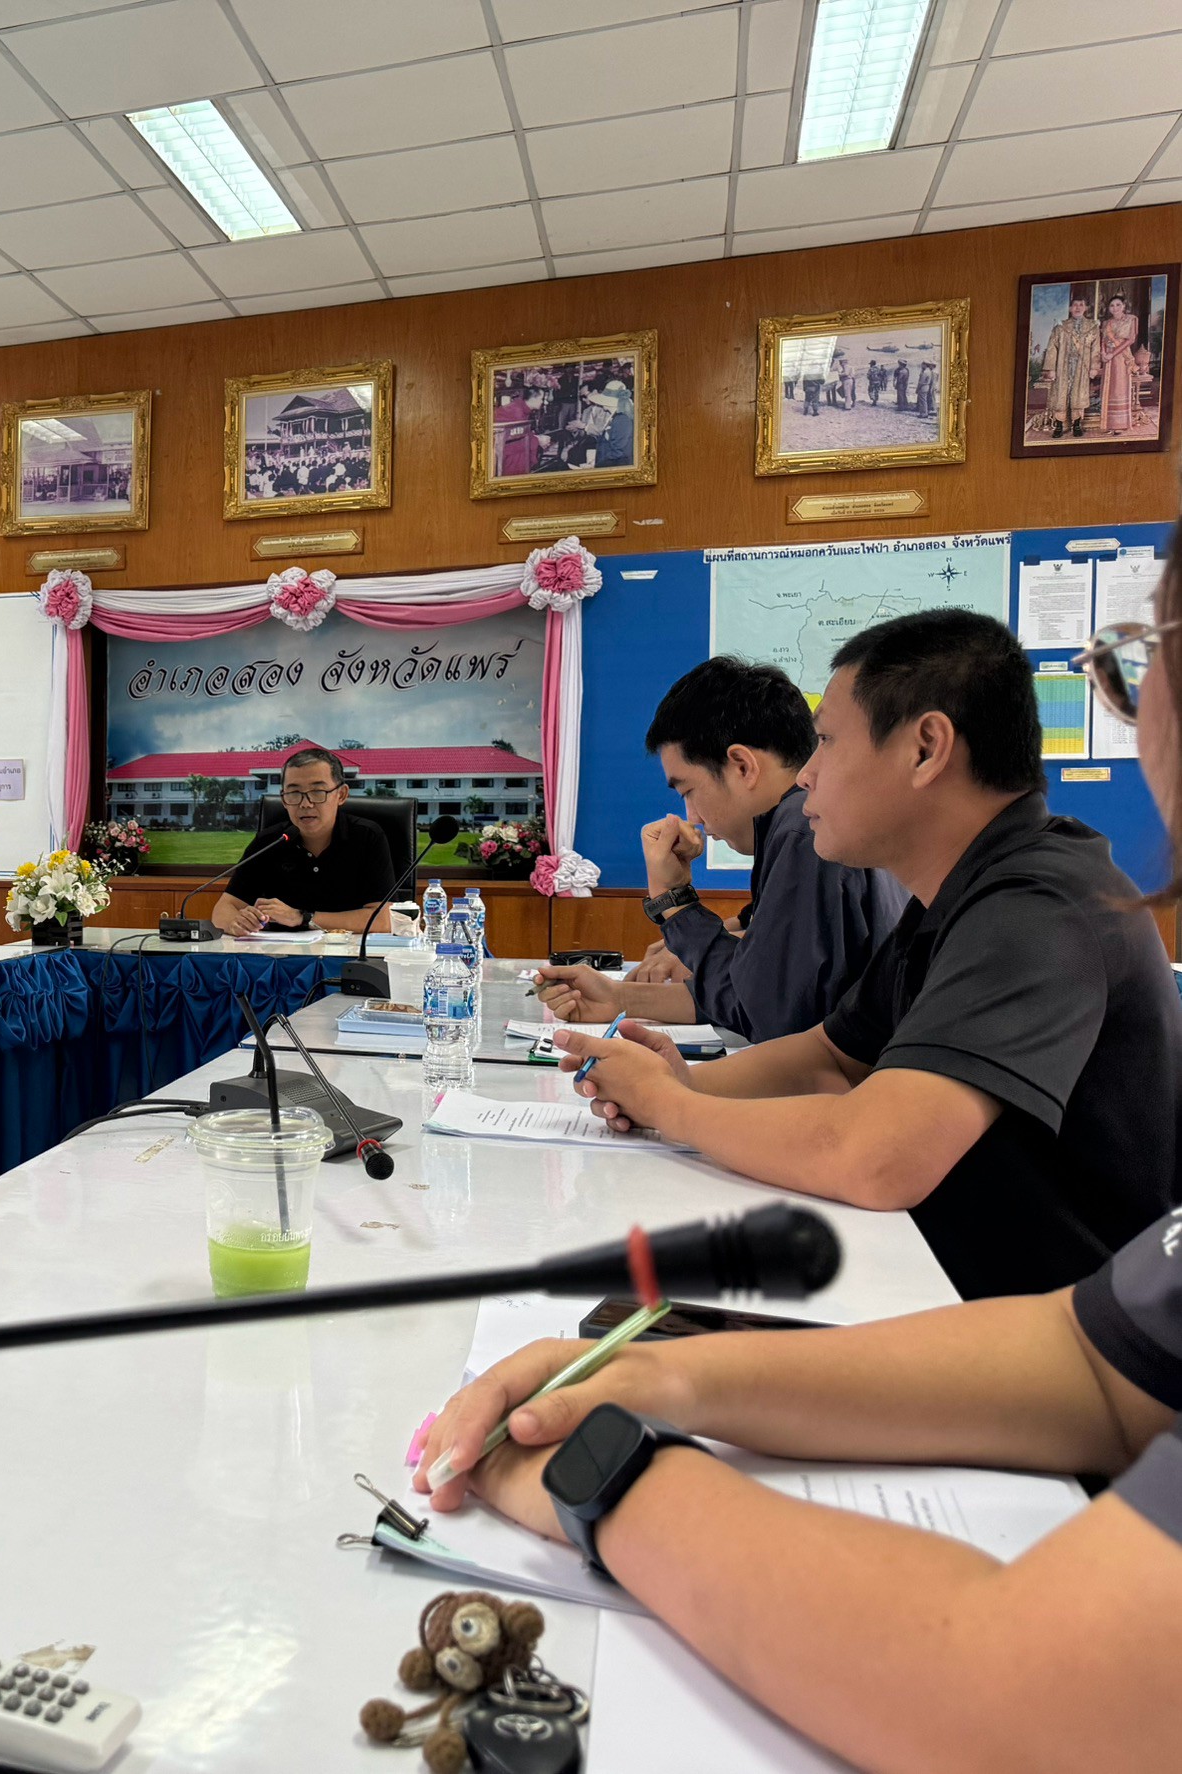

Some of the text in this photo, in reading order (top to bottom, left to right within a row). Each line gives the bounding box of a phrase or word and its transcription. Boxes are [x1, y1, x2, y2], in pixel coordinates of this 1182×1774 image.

[705, 533, 1012, 562] แผนที่สถานการณ์หมอกควันและไฟป่า อำเภอสอง จังหวัดแพร่
[818, 616, 856, 626] ต.สะเอียบ
[127, 639, 526, 700] อำเภอสอง จังหวัดแพร่
